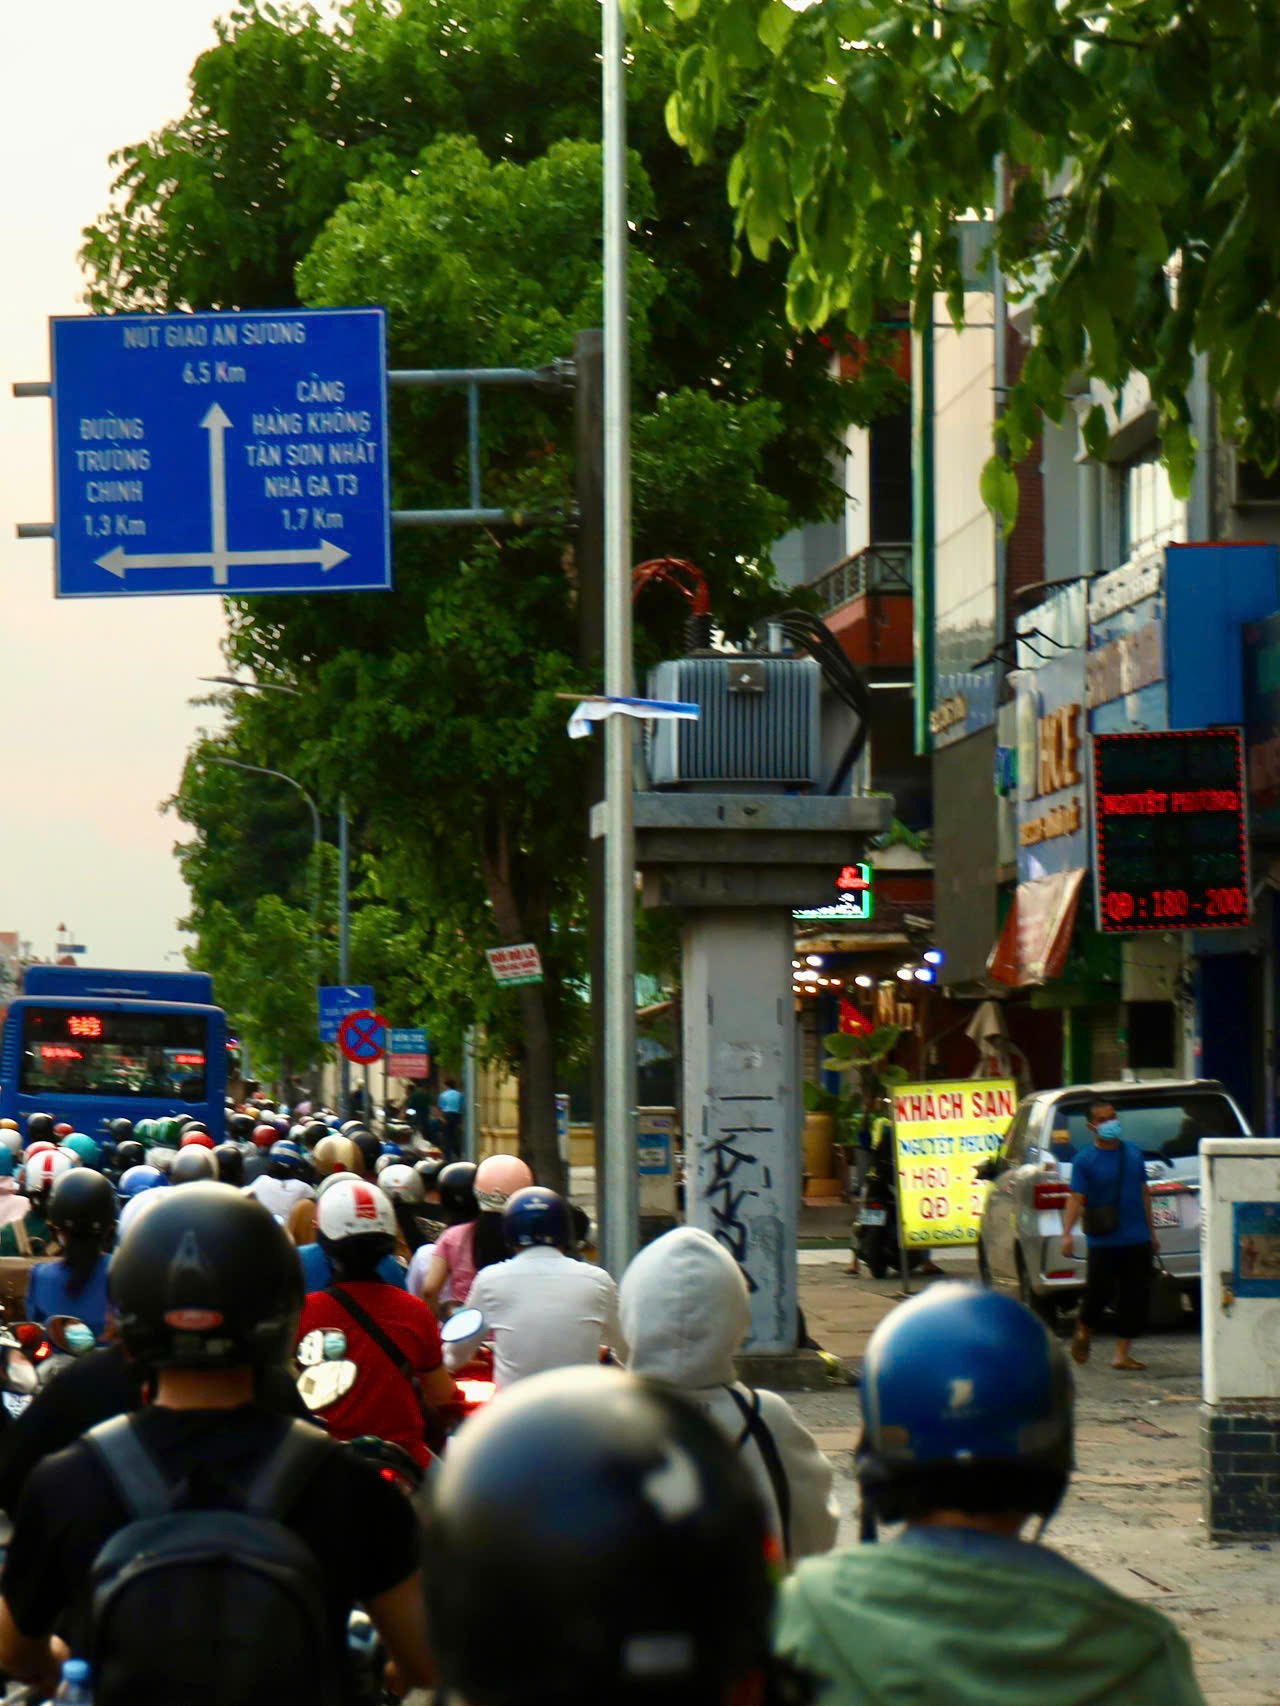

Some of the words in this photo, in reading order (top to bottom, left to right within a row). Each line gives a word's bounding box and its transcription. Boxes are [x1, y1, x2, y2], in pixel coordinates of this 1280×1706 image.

[123, 320, 160, 348] NÚT
[165, 324, 208, 347] GIAO
[212, 323, 238, 346] AN
[214, 361, 247, 383] Km
[252, 406, 303, 435] HÀNG
[307, 406, 371, 434] KHÔNG
[86, 480, 144, 503] CHINH
[264, 469, 304, 498] NHÀ
[307, 475, 332, 496] GA
[335, 473, 359, 496] T3
[115, 514, 147, 536] Km
[313, 507, 344, 529] Km
[1205, 888, 1243, 917] 200
[895, 1088, 963, 1121] KHÁCH
[972, 1090, 1015, 1123] SẠN
